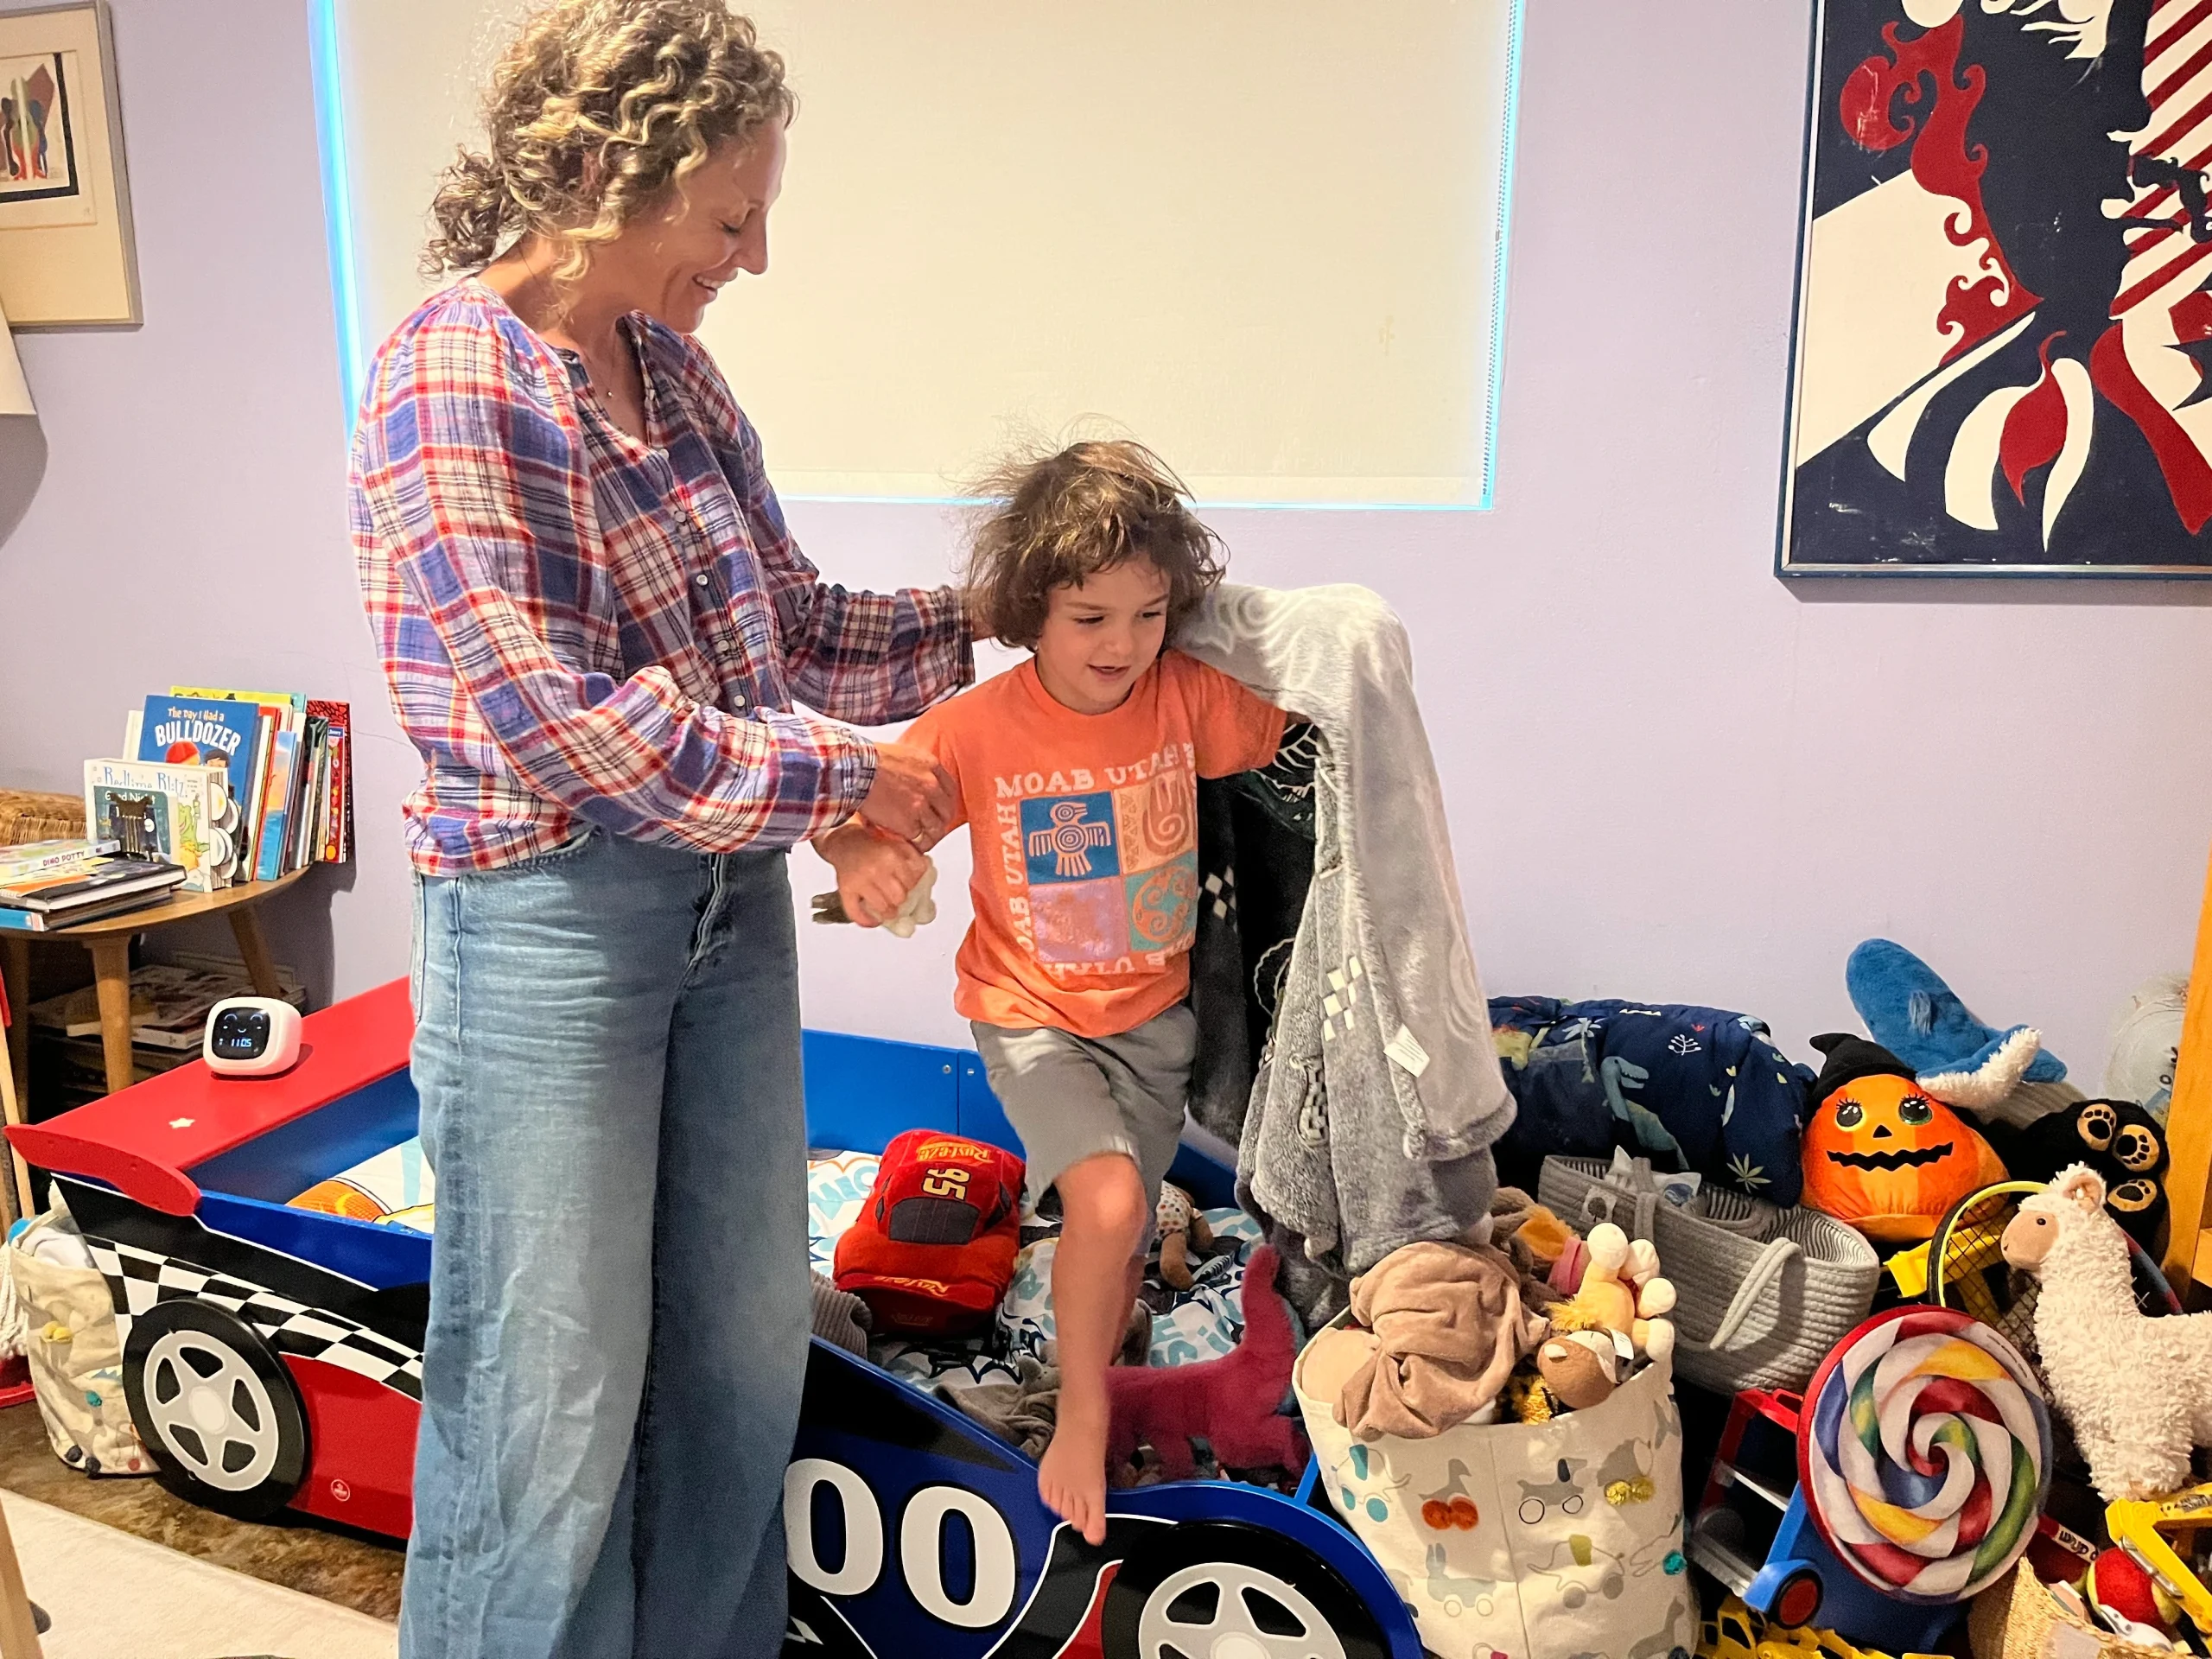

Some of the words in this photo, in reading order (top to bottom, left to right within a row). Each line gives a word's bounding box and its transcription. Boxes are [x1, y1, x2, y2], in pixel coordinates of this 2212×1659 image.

[168, 706, 181, 718] The
[183, 709, 197, 723] Day
[198, 710, 202, 720] I
[203, 709, 219, 722] Had
[219, 713, 225, 722] a
[155, 720, 241, 756] BULLDOZER
[995, 768, 1095, 799] MOAB
[1104, 743, 1180, 785] UTAH
[105, 790, 127, 802] Gd
[130, 792, 156, 804] Nit
[42, 856, 60, 867] DINO
[61, 850, 85, 862] POTTY
[996, 802, 1024, 886] UTAH
[1009, 896, 1038, 951] OAB
[922, 1167, 970, 1201] 95
[784, 1458, 1016, 1628] 00
